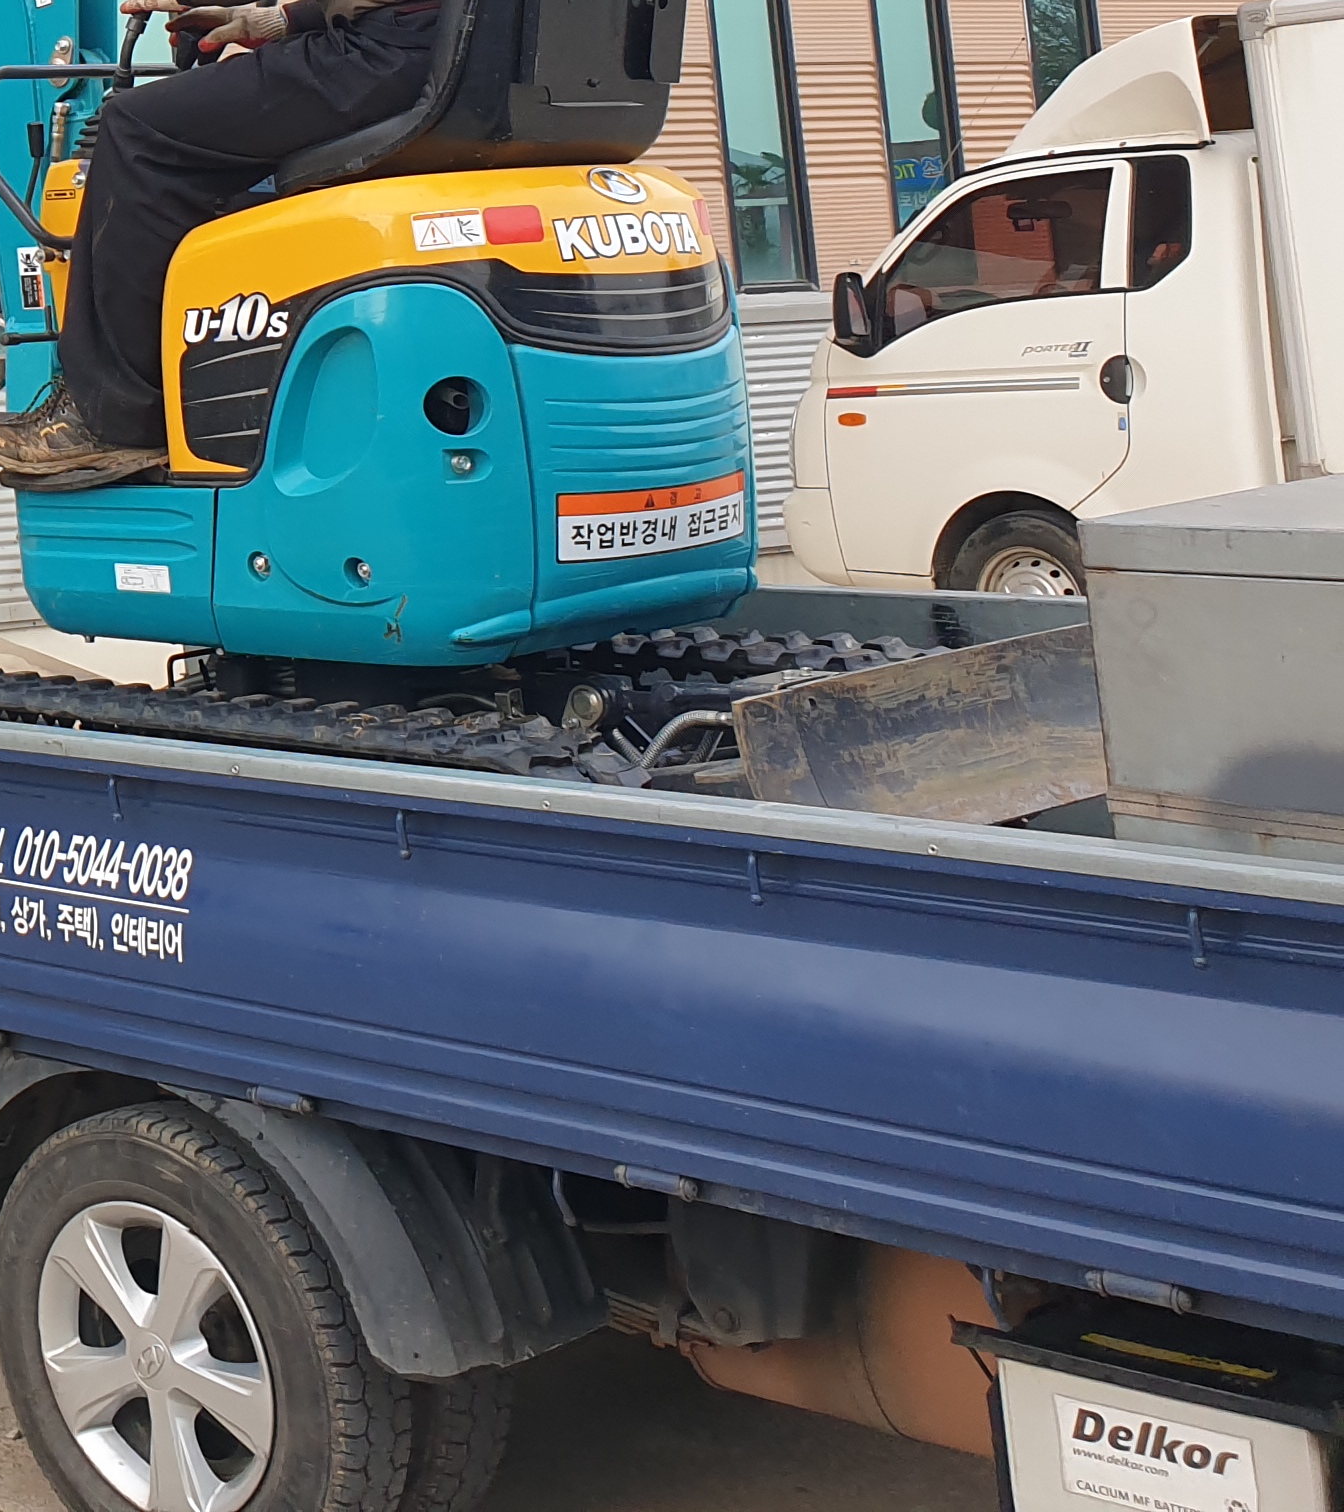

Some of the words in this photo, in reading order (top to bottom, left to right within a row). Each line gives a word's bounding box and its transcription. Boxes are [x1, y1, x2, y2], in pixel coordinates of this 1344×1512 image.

[553, 211, 701, 261] KUBOTA
[570, 514, 678, 551] 작업반경내
[687, 500, 741, 538] 접근금지
[13, 826, 192, 900] 010-5044-0038
[11, 896, 52, 942] 상가,
[56, 904, 105, 951] 주택),
[111, 913, 184, 963] 인테리어
[1072, 1408, 1239, 1475] Delkor
[1076, 1479, 1130, 1502] CALCIUM
[1133, 1493, 1151, 1507] MF
